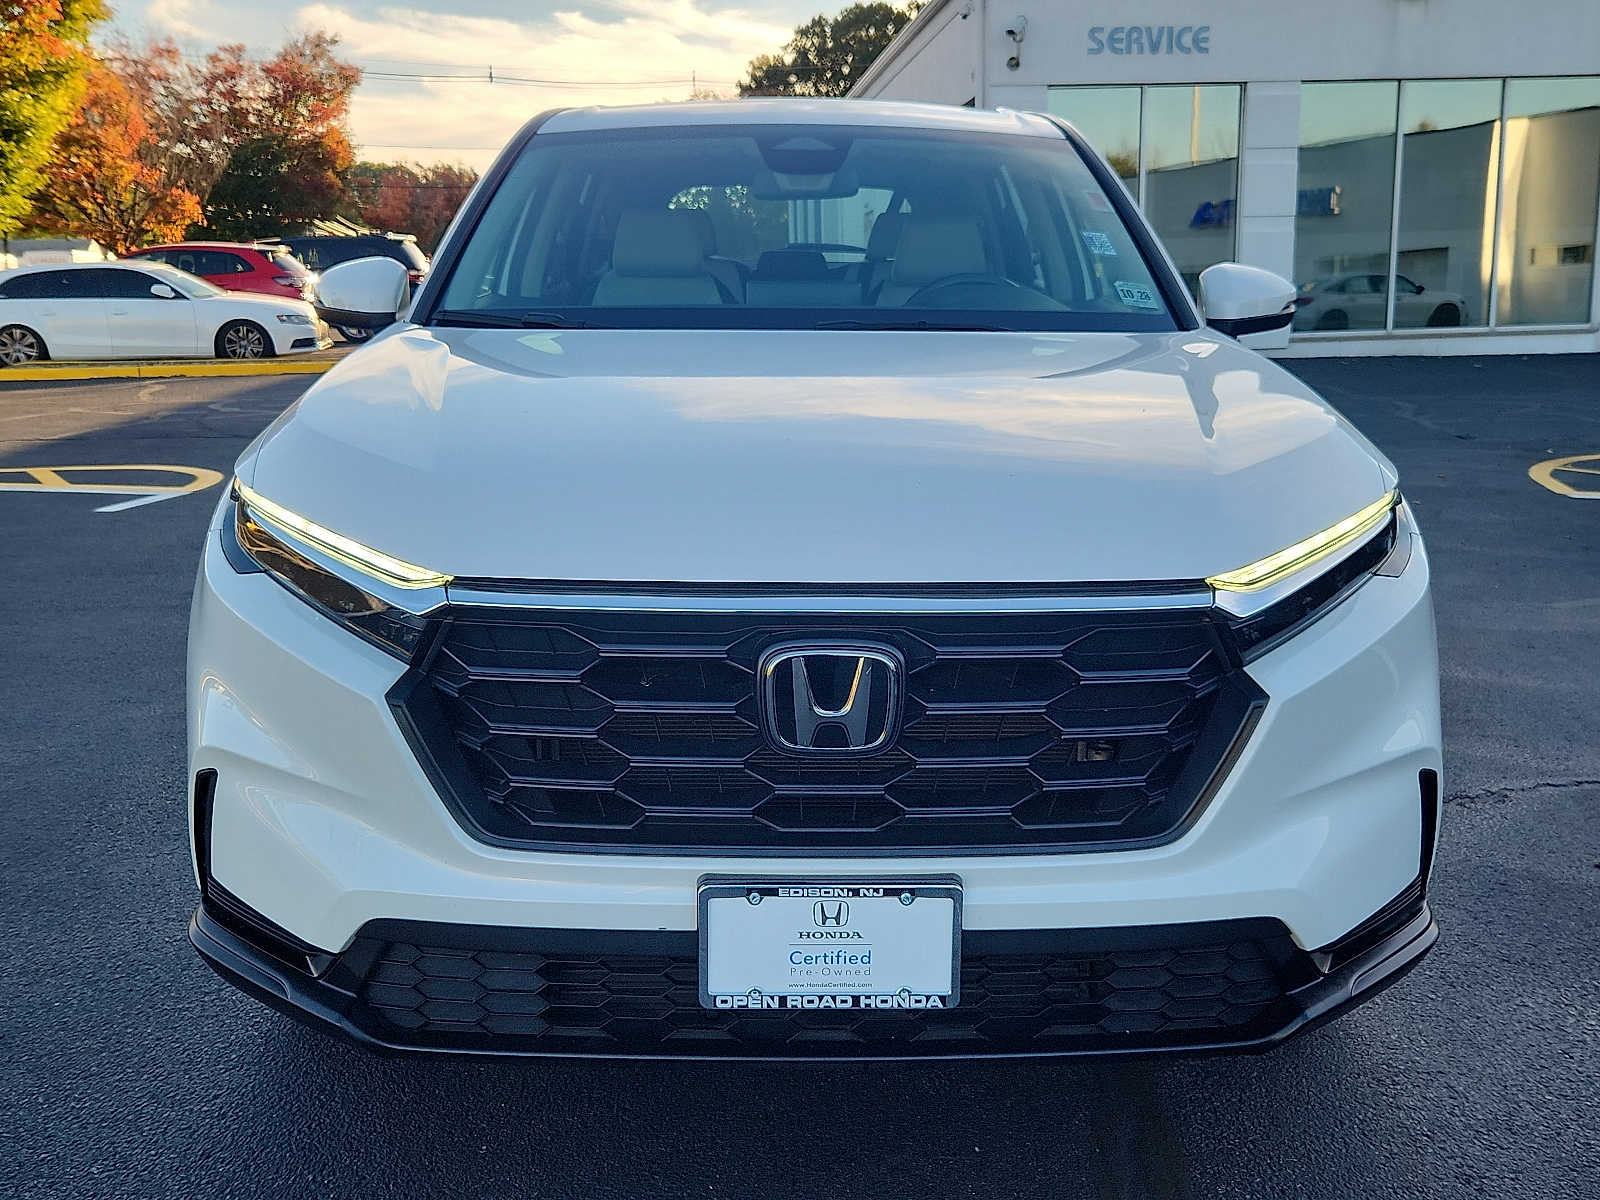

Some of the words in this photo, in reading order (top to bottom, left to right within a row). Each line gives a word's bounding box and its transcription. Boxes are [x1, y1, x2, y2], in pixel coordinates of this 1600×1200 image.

[1087, 25, 1211, 55] SERVICE
[859, 887, 885, 898] NJ
[798, 931, 864, 939] HONDA
[789, 949, 872, 965] Certified
[789, 967, 872, 976] Pre-Owned
[715, 994, 779, 1008] OPEN
[787, 994, 853, 1008] ROAD
[859, 994, 944, 1008] HONDA
